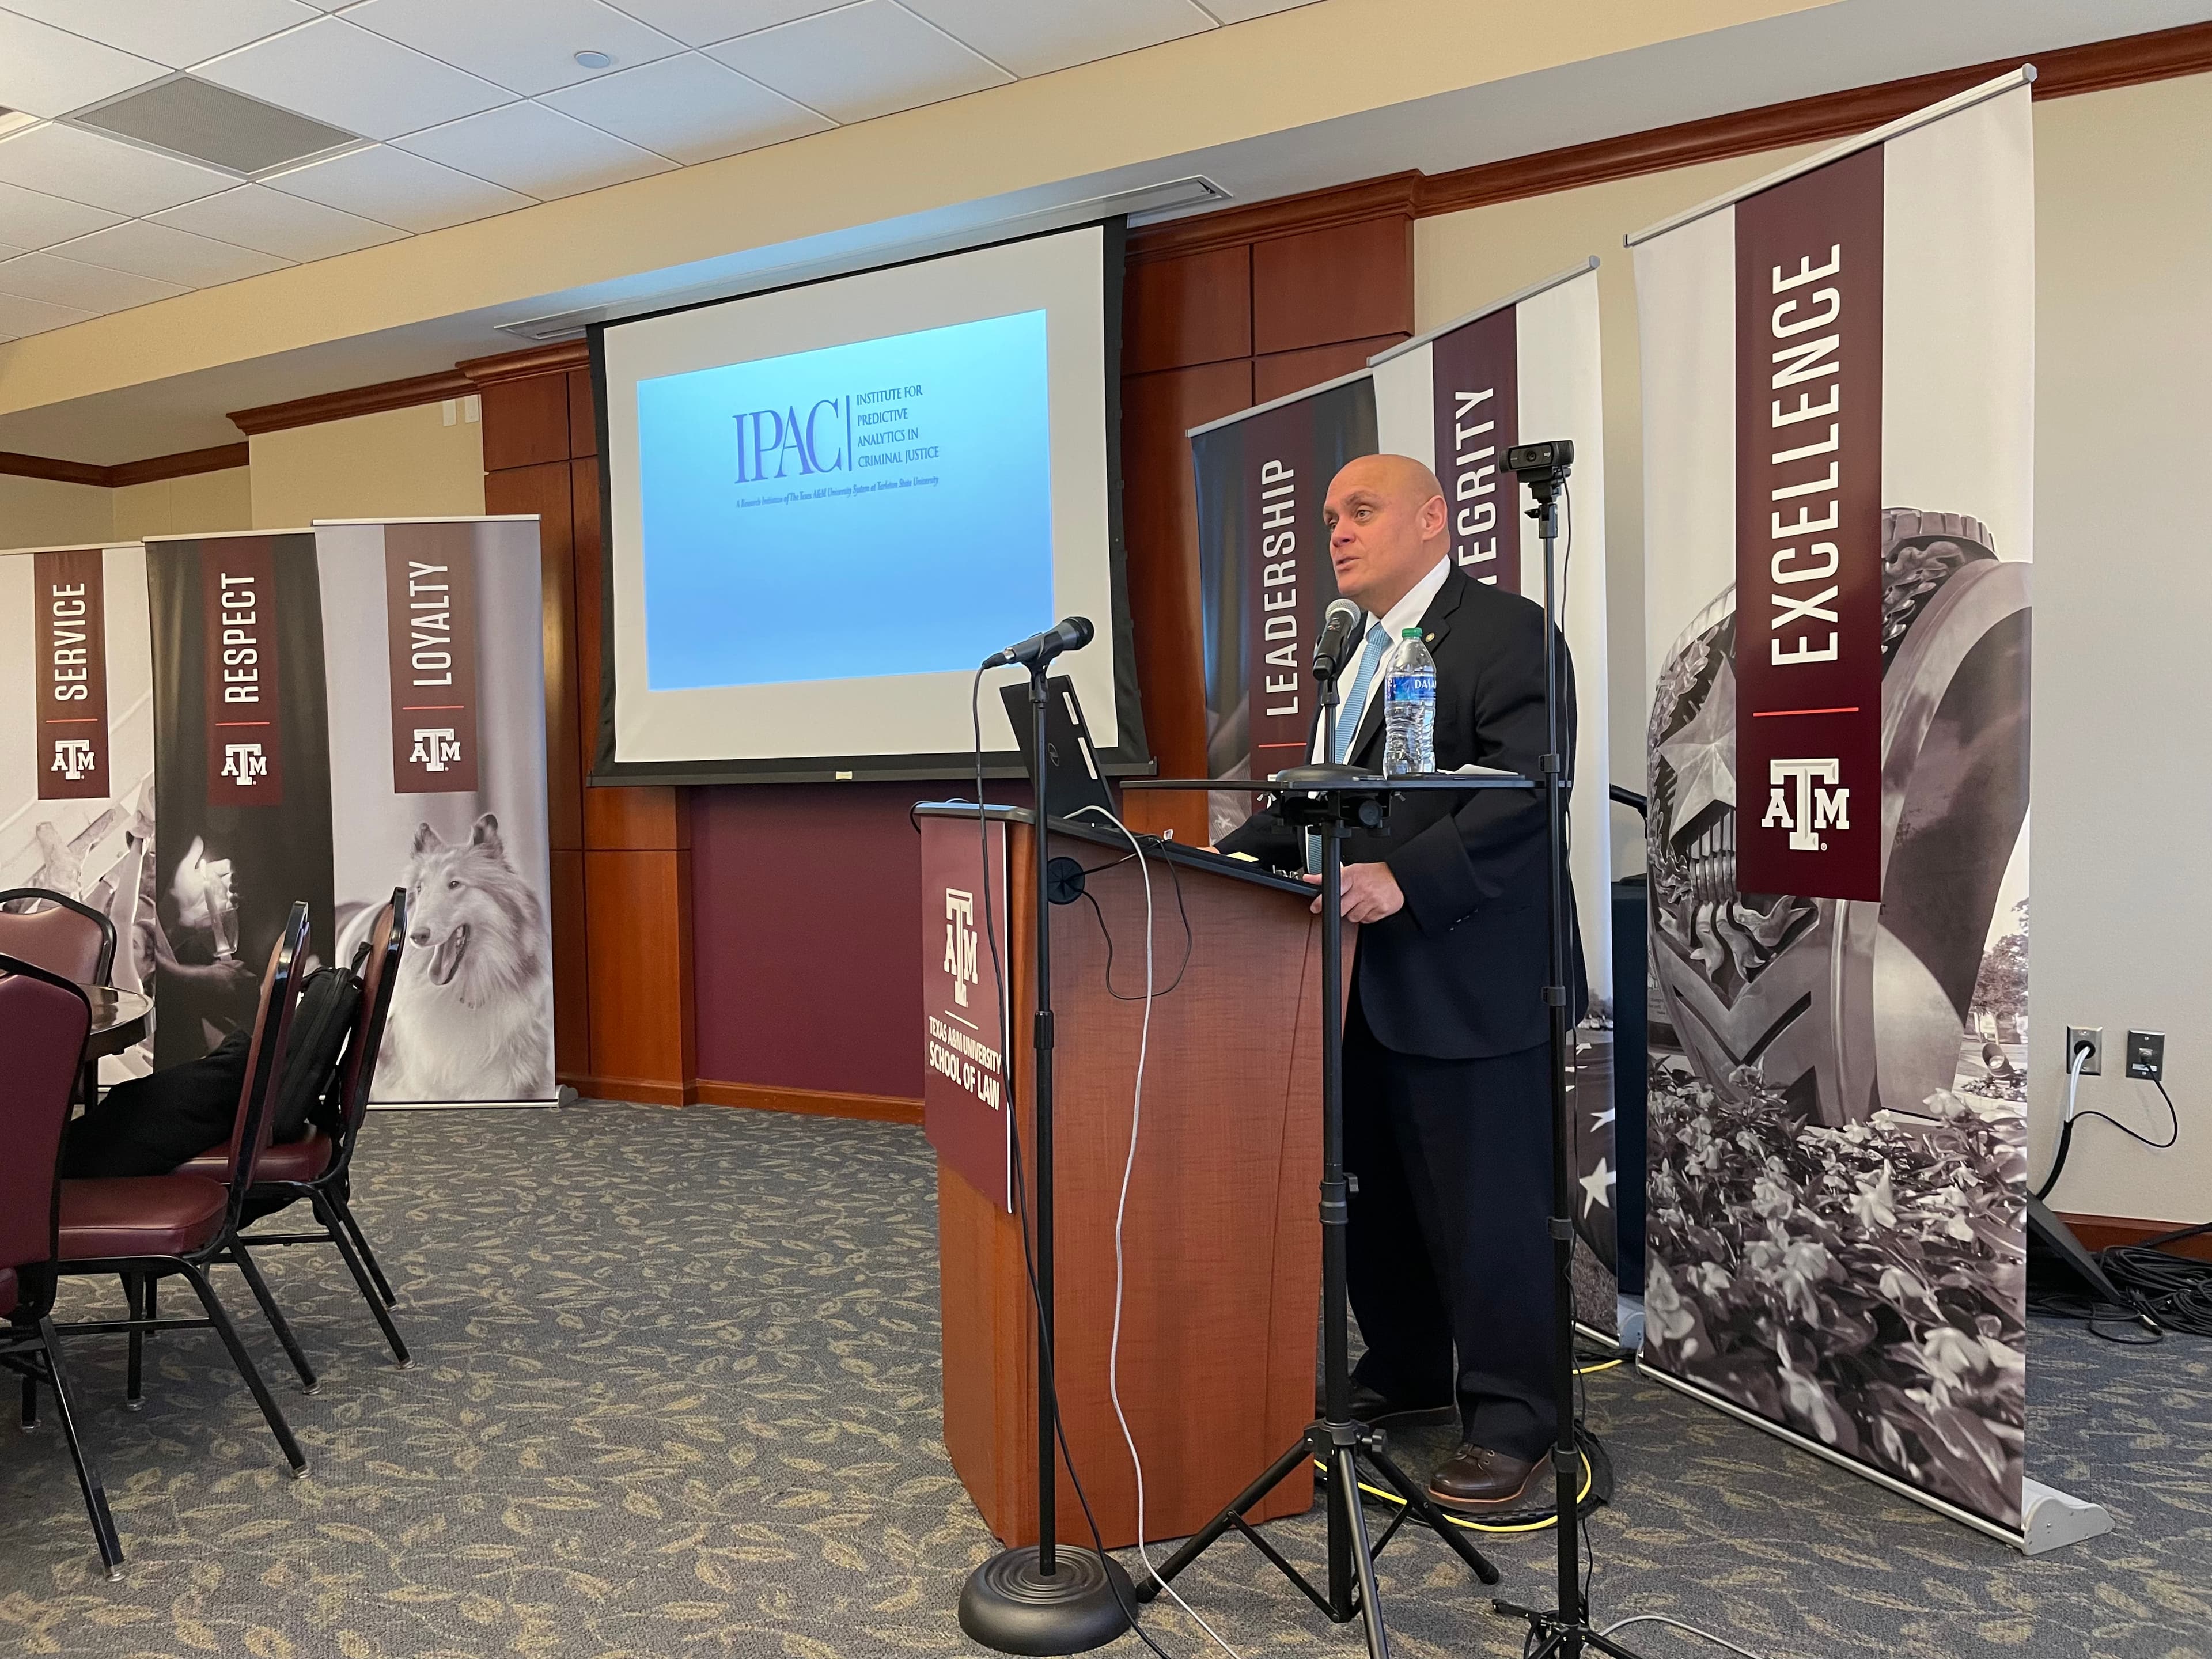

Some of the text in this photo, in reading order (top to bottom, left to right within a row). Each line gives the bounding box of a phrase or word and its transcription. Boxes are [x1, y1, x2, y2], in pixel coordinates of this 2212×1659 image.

[857, 385, 923, 406] INSTITUTE FOR
[858, 408, 908, 426] PREDICTIVE
[732, 398, 842, 484] IPAC
[858, 427, 918, 447] ANALYTICS IN
[858, 446, 939, 468] CRIMINAL JUSTICE
[1771, 244, 1840, 665] EXCELLENCE
[1455, 387, 1497, 585] EGRITY
[408, 561, 452, 686] LOYALTY
[1262, 460, 1298, 716] LEADERSHIP
[52, 583, 88, 701] SERVICE
[221, 573, 259, 703] RESPECT
[1415, 678, 1437, 691] DASA
[929, 1016, 1002, 1075] TEXAS A&M UNIVERSITY
[930, 1041, 1000, 1111] SCHOOL OF LAW
